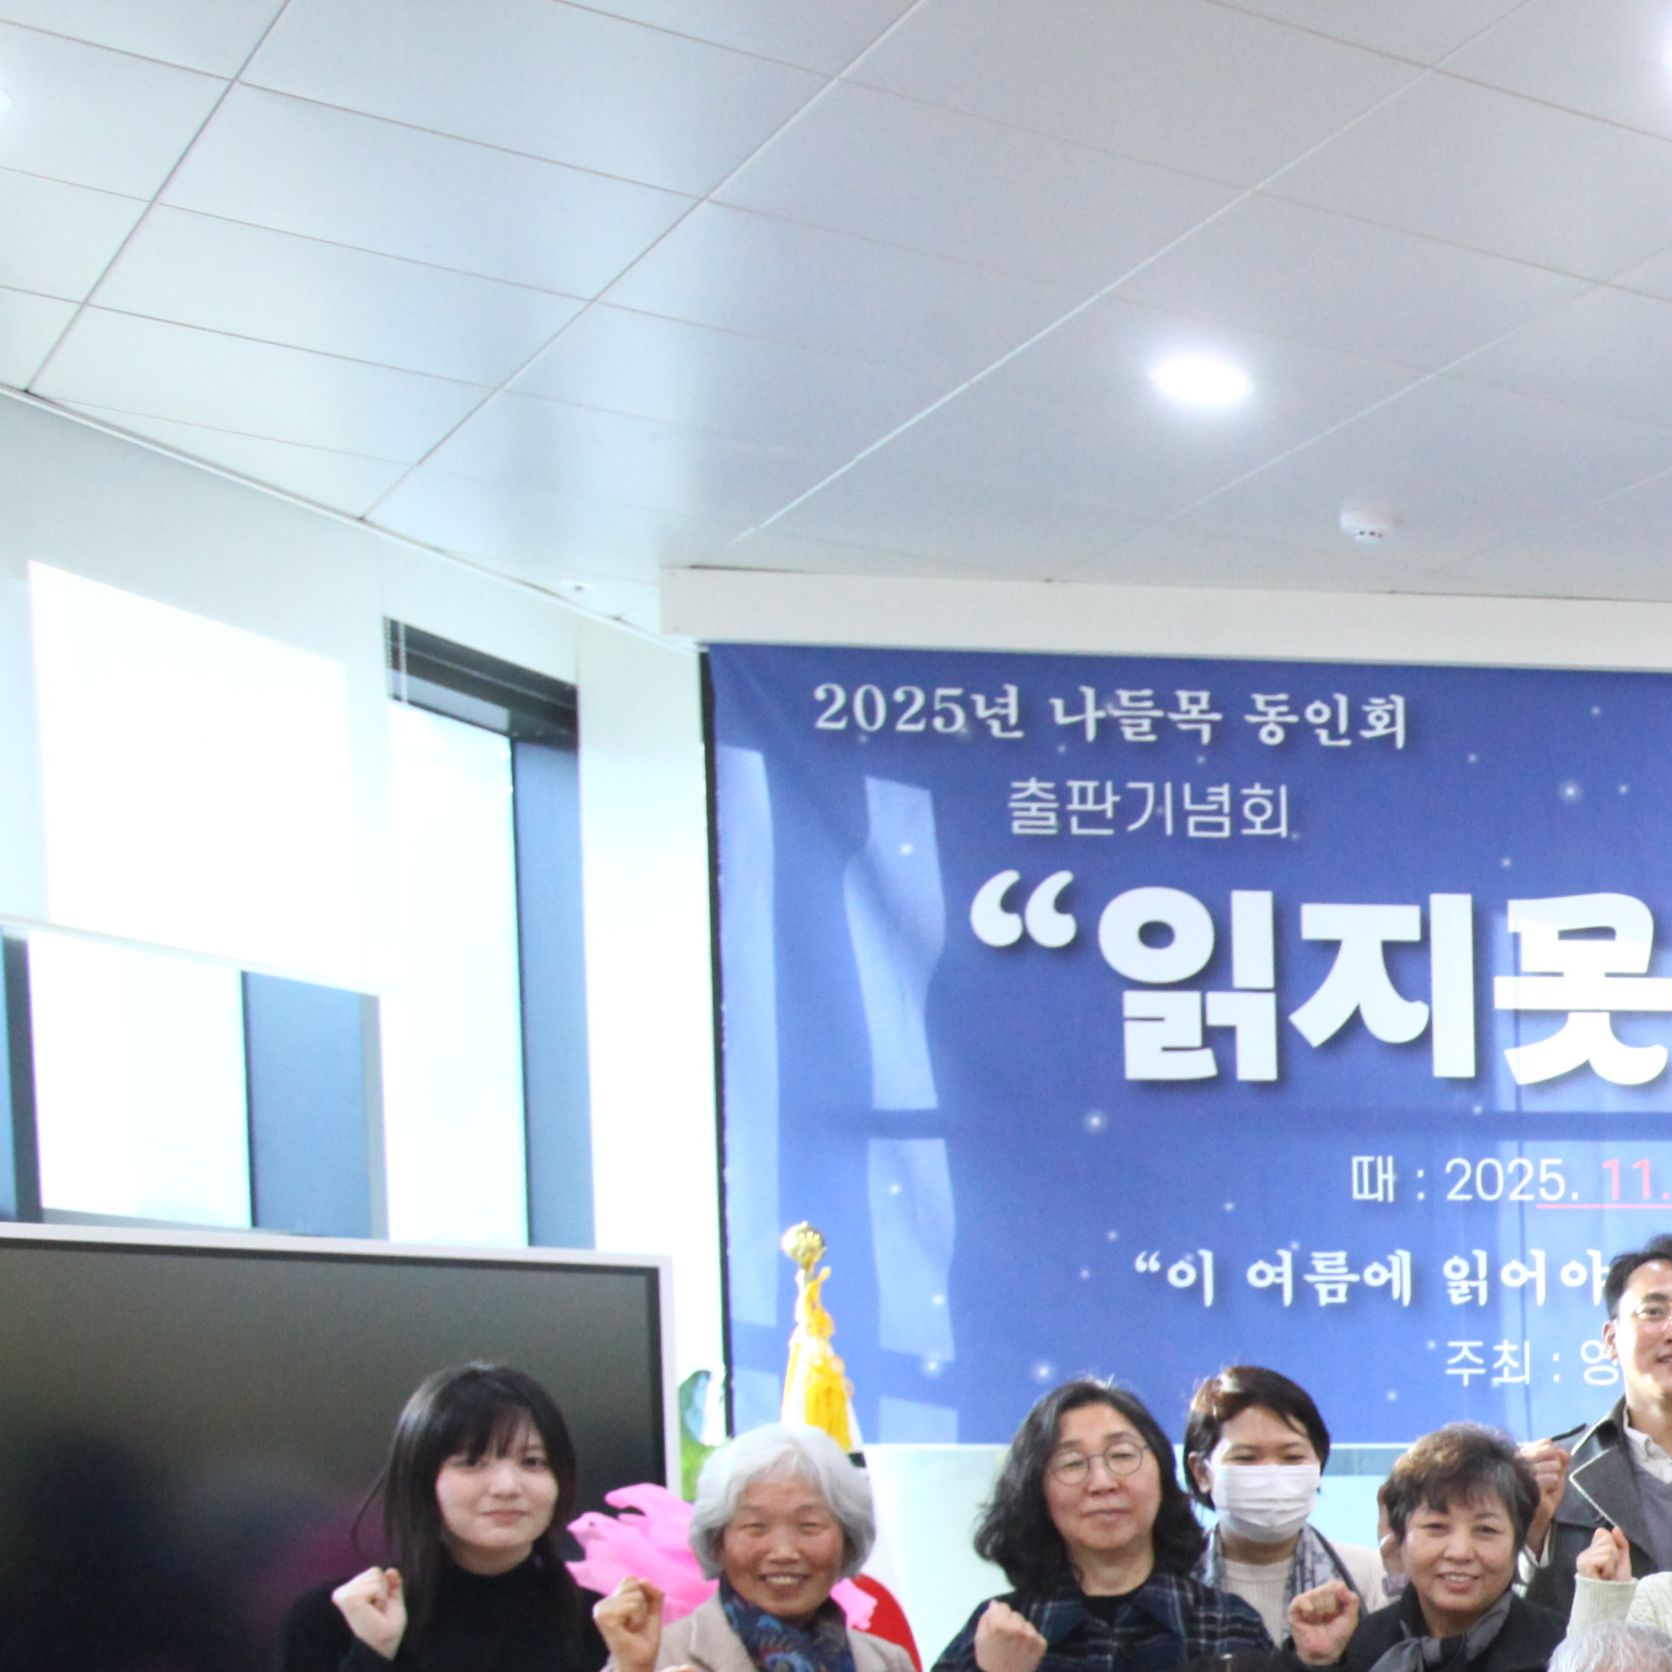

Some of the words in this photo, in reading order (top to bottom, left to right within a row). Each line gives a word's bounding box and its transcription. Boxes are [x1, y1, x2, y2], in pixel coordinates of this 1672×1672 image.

[813, 682, 1024, 742] 2025년
[1048, 685, 1224, 750] 나들목
[1244, 691, 1407, 751] 동인회
[1007, 776, 1292, 840] 출판기념회
[1350, 1155, 1396, 1204] 때
[1444, 1157, 1579, 1202] 2025.
[1601, 1158, 1670, 1201] 11.
[1133, 1247, 1215, 1309] “이
[1245, 1247, 1412, 1309] 여름에
[1444, 1337, 1532, 1388] 주최
